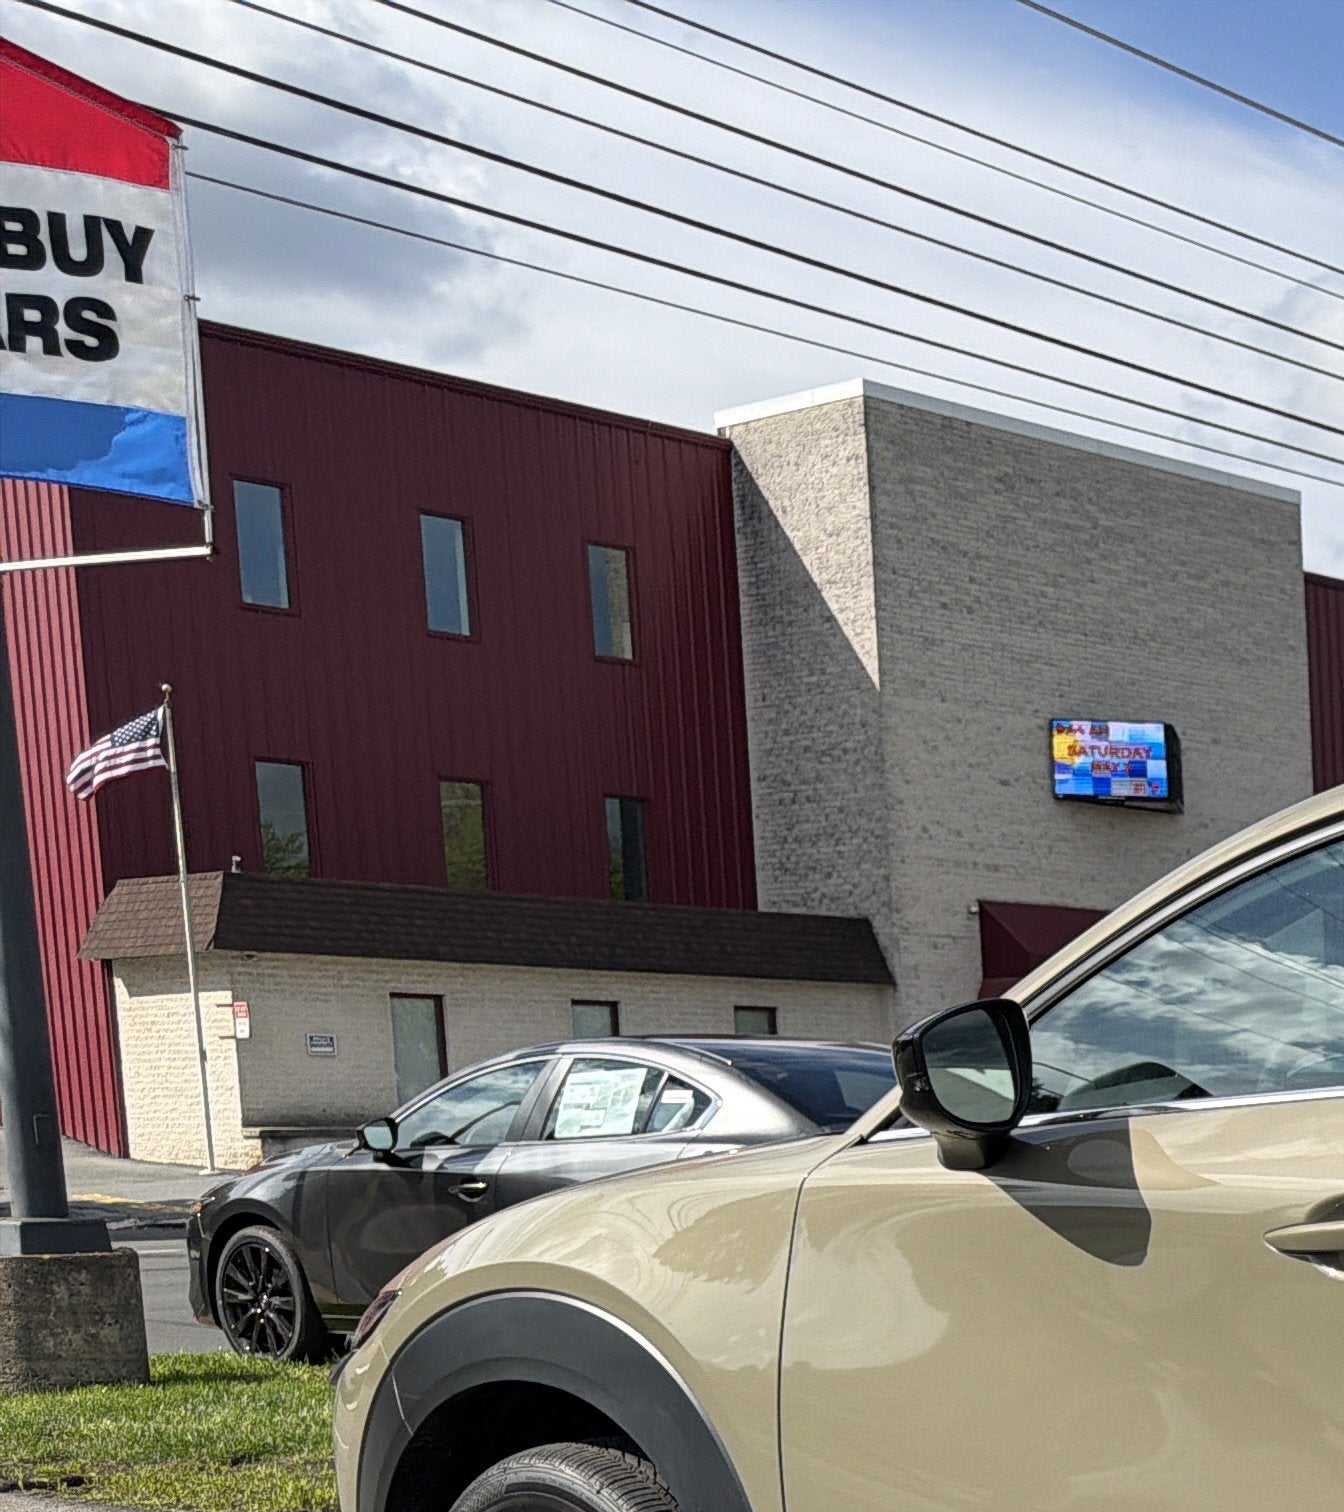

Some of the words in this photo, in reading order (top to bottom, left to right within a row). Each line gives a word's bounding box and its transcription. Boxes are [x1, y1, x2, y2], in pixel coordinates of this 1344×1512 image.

[0, 206, 155, 284] BUY
[0, 293, 120, 361] RS
[1067, 744, 1152, 759] SATURDAY
